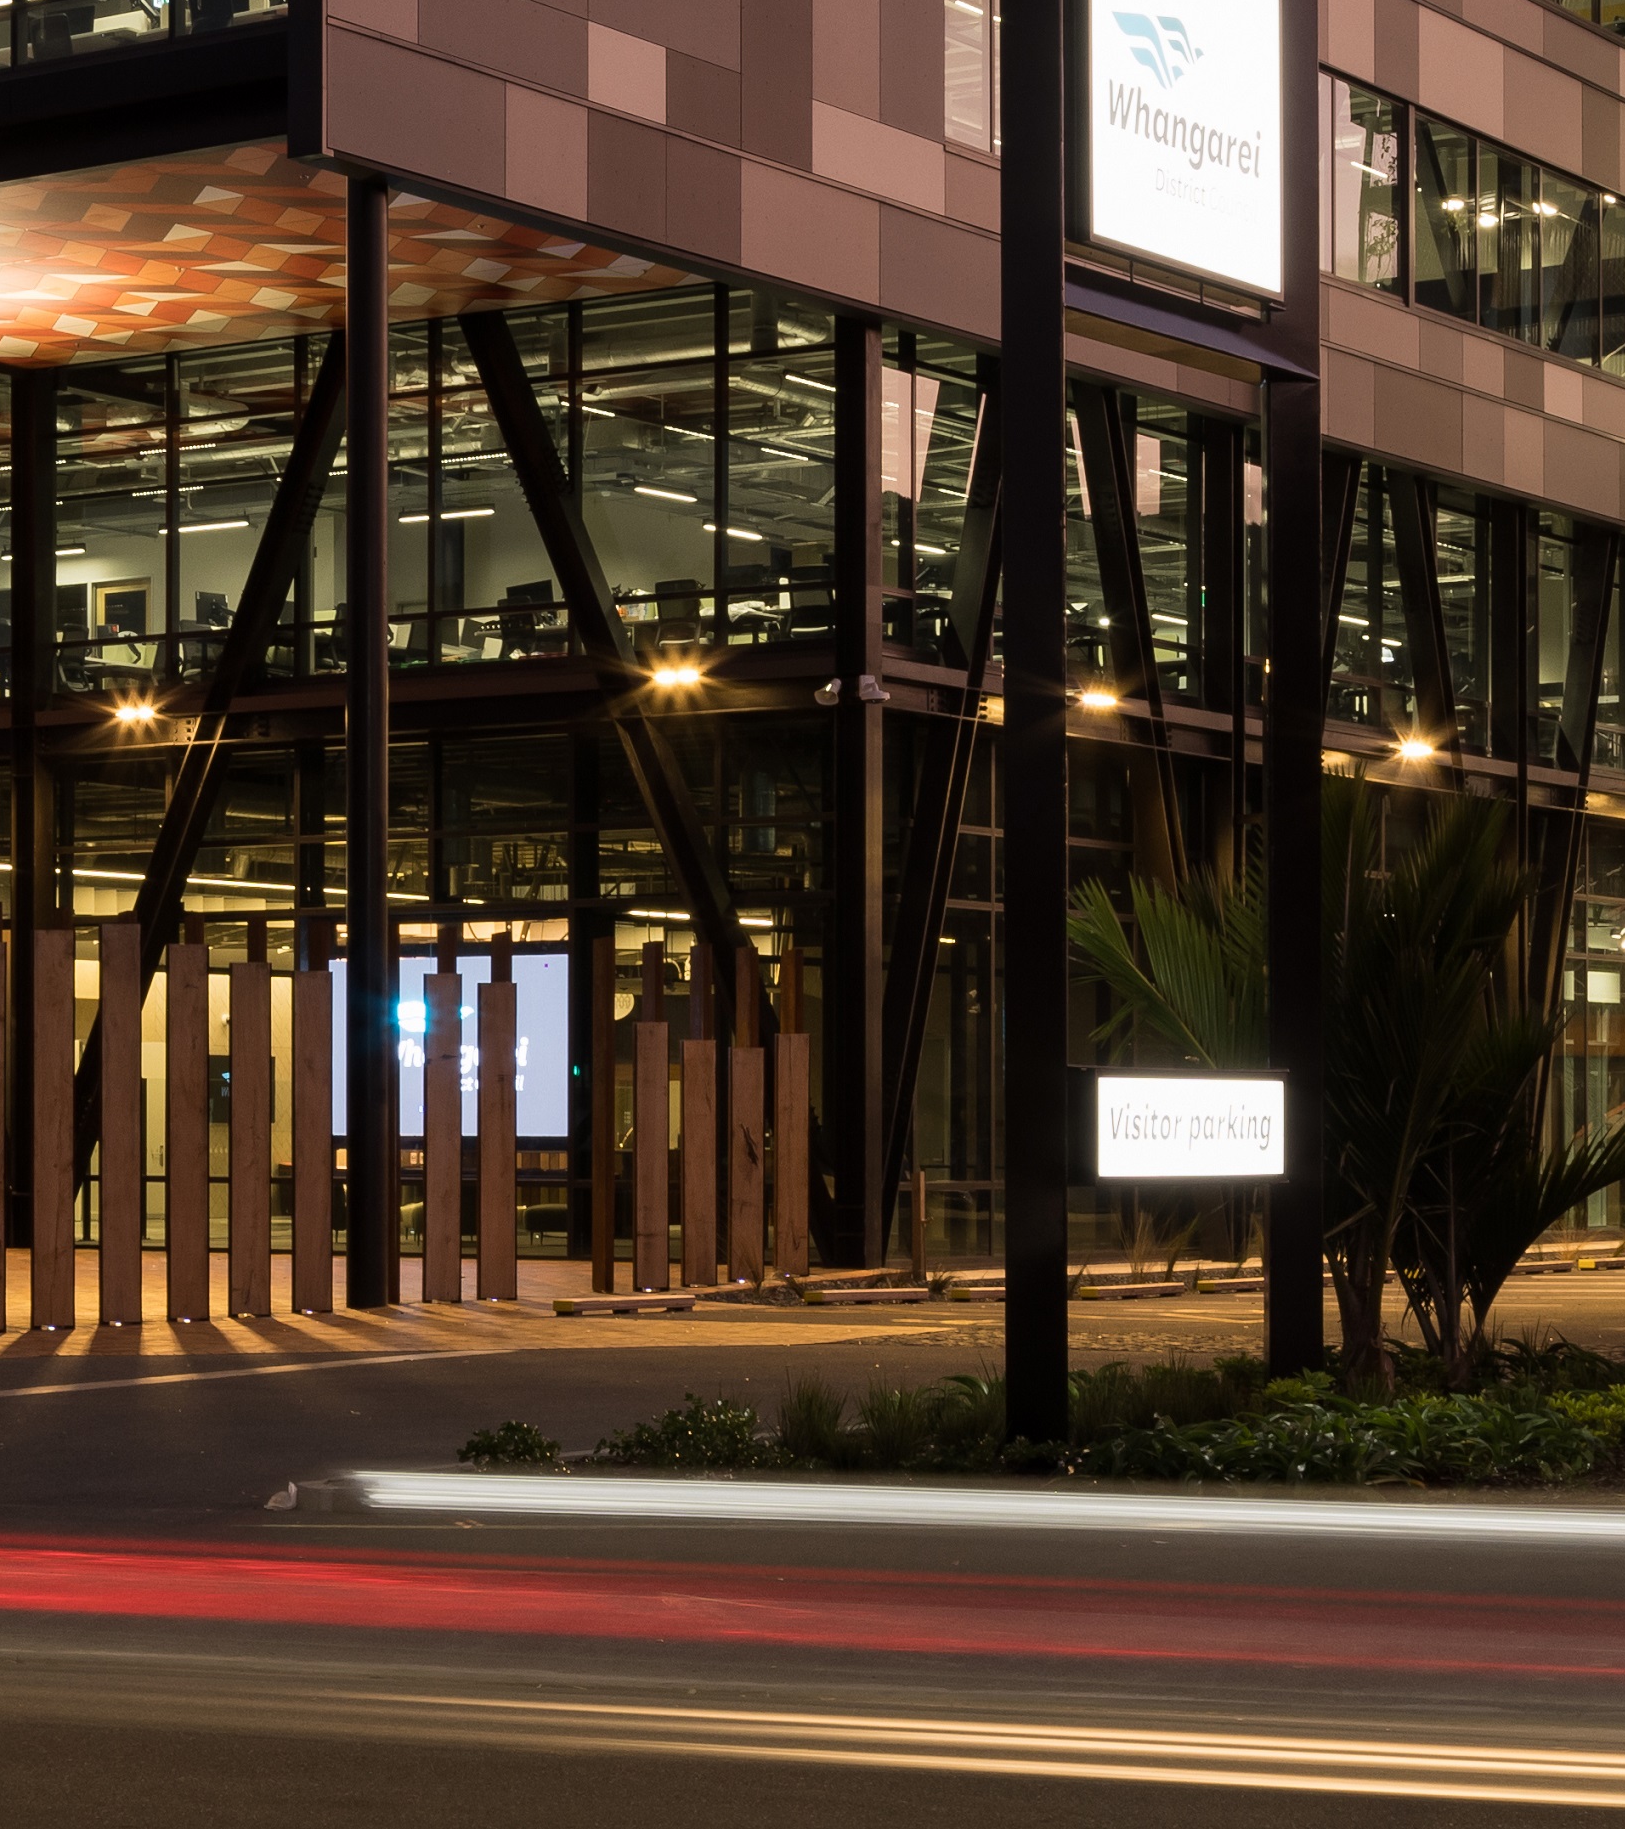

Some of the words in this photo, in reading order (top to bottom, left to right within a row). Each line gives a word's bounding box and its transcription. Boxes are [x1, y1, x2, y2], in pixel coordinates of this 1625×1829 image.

[1108, 78, 1261, 178] Whangarei
[1155, 167, 1206, 207] District
[1110, 1102, 1183, 1141] Visitor
[1189, 1104, 1272, 1151] parking
